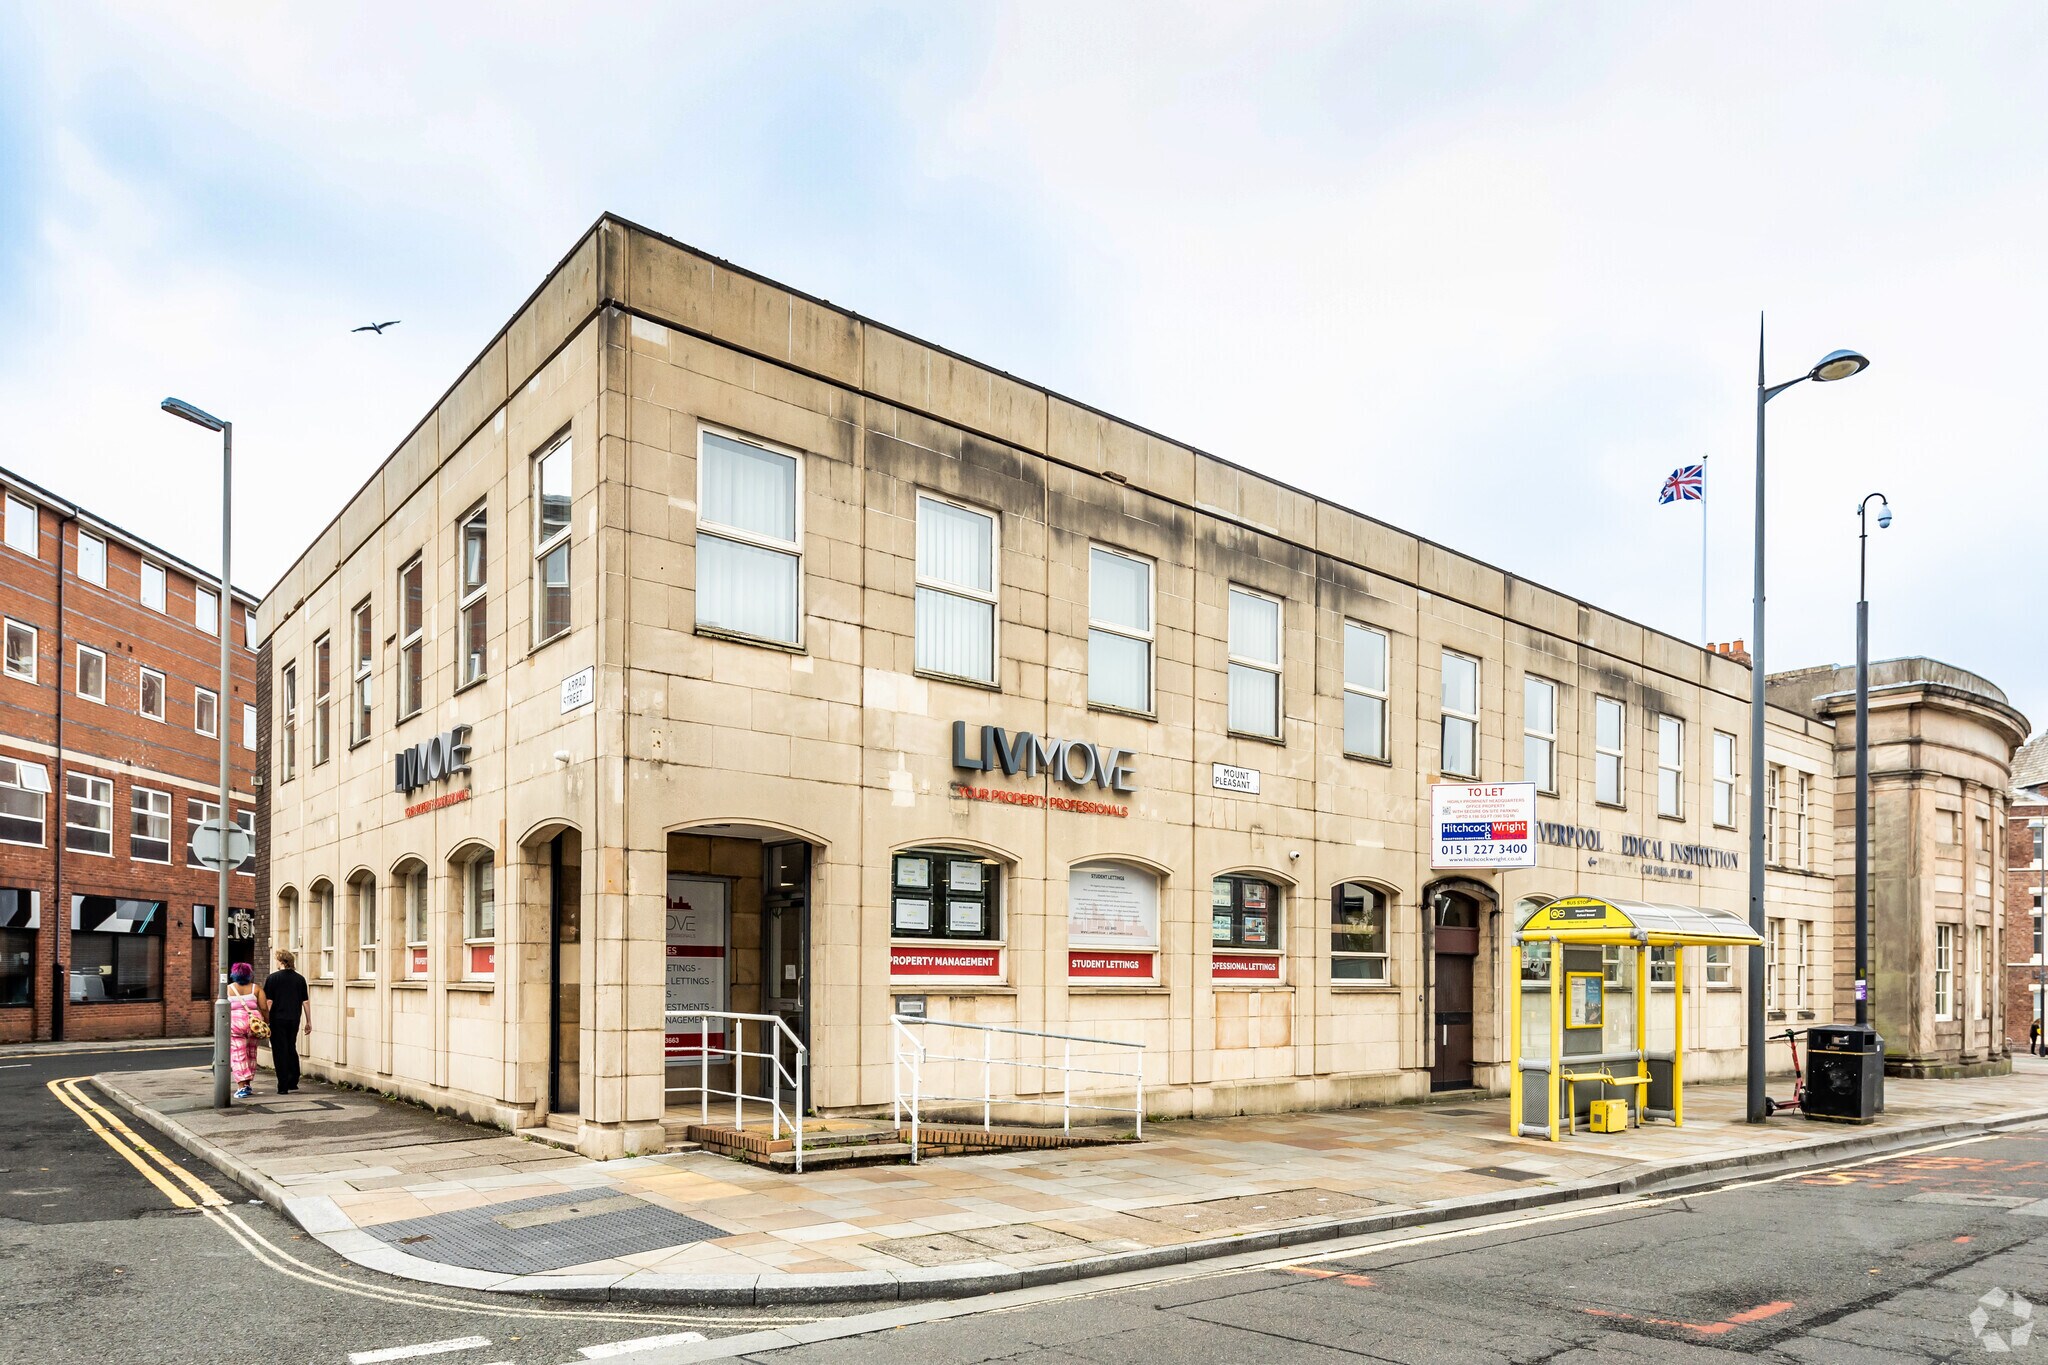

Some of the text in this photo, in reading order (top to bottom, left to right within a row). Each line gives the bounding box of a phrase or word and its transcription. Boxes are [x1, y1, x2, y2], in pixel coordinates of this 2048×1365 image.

[568, 674, 586, 692] ARRAD
[563, 689, 583, 706] STREET
[952, 720, 1138, 793] LIVMOVE
[1224, 768, 1250, 780] MOUNT
[1215, 776, 1250, 789] PLEASANT
[1468, 788, 1504, 797] TO LET
[958, 786, 1128, 818] YOUR PROPERTY PROFESSIONALS
[1442, 822, 1526, 833] Hitchcock Wright
[1442, 844, 1527, 854] 0151 227 3400
[1670, 842, 1739, 869] INSTITUTION
[890, 956, 994, 966] PROPERTY MANAGEMENT
[1072, 960, 1139, 969] STUDENT LETTINGS
